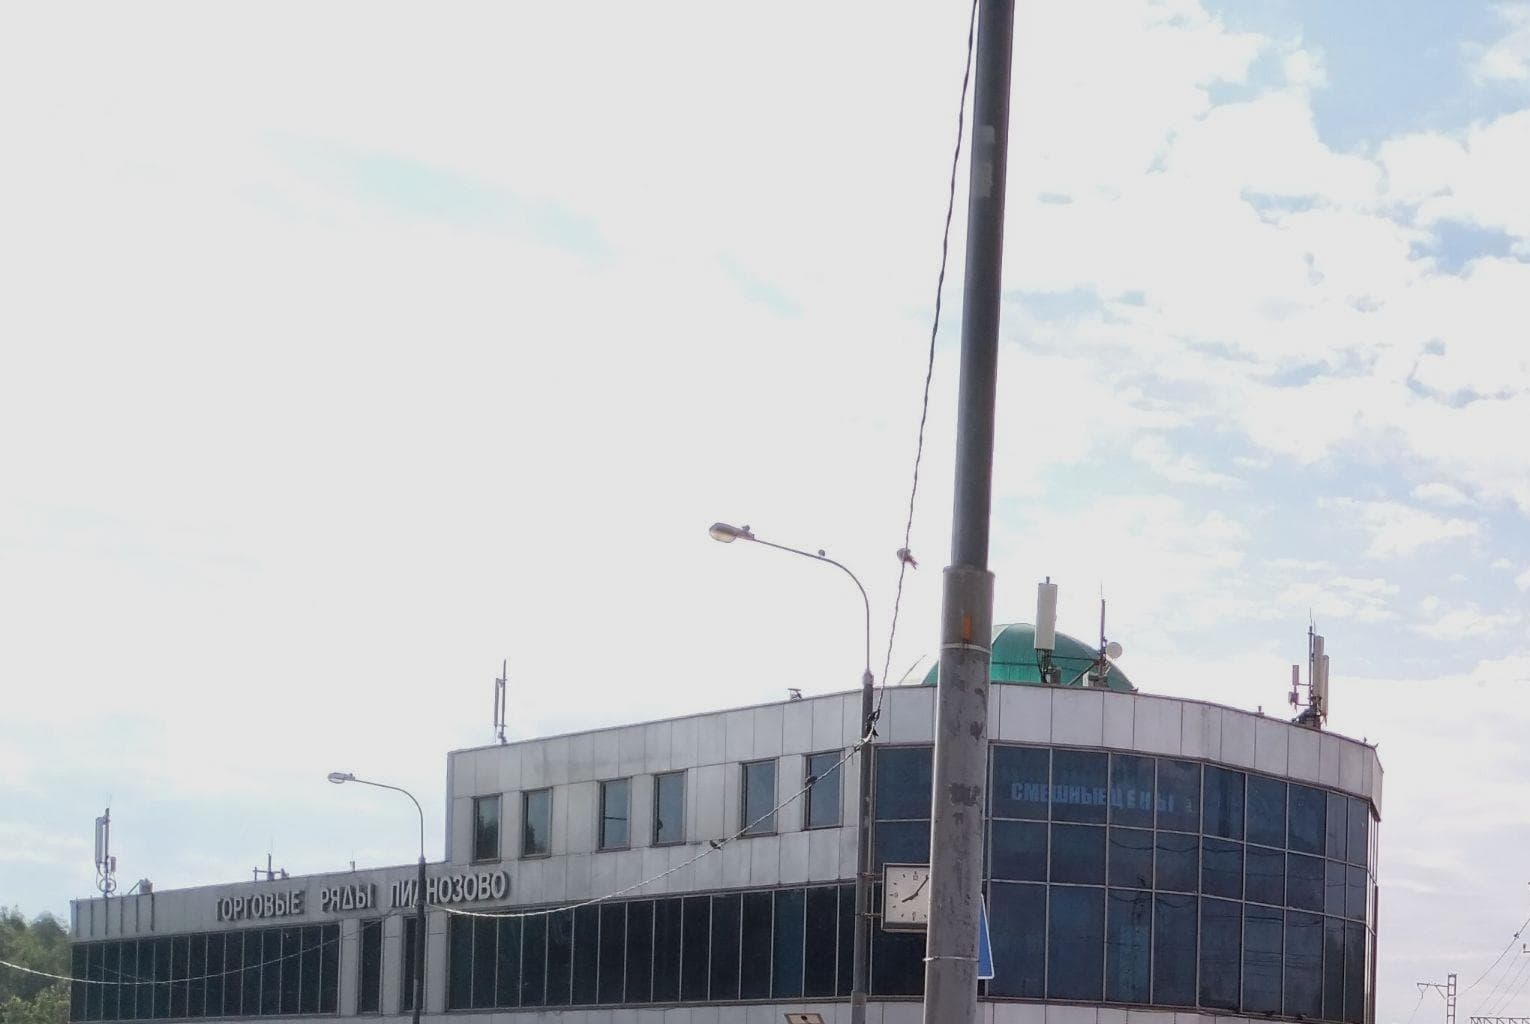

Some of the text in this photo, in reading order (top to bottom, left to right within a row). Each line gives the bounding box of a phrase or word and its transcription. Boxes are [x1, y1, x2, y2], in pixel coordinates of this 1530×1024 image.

[1011, 783, 1174, 812] СМЕШНЫЕ ЦЕНЫ
[216, 891, 303, 921] ТОРГОВЫЕ
[320, 883, 374, 911] РЯДЫ
